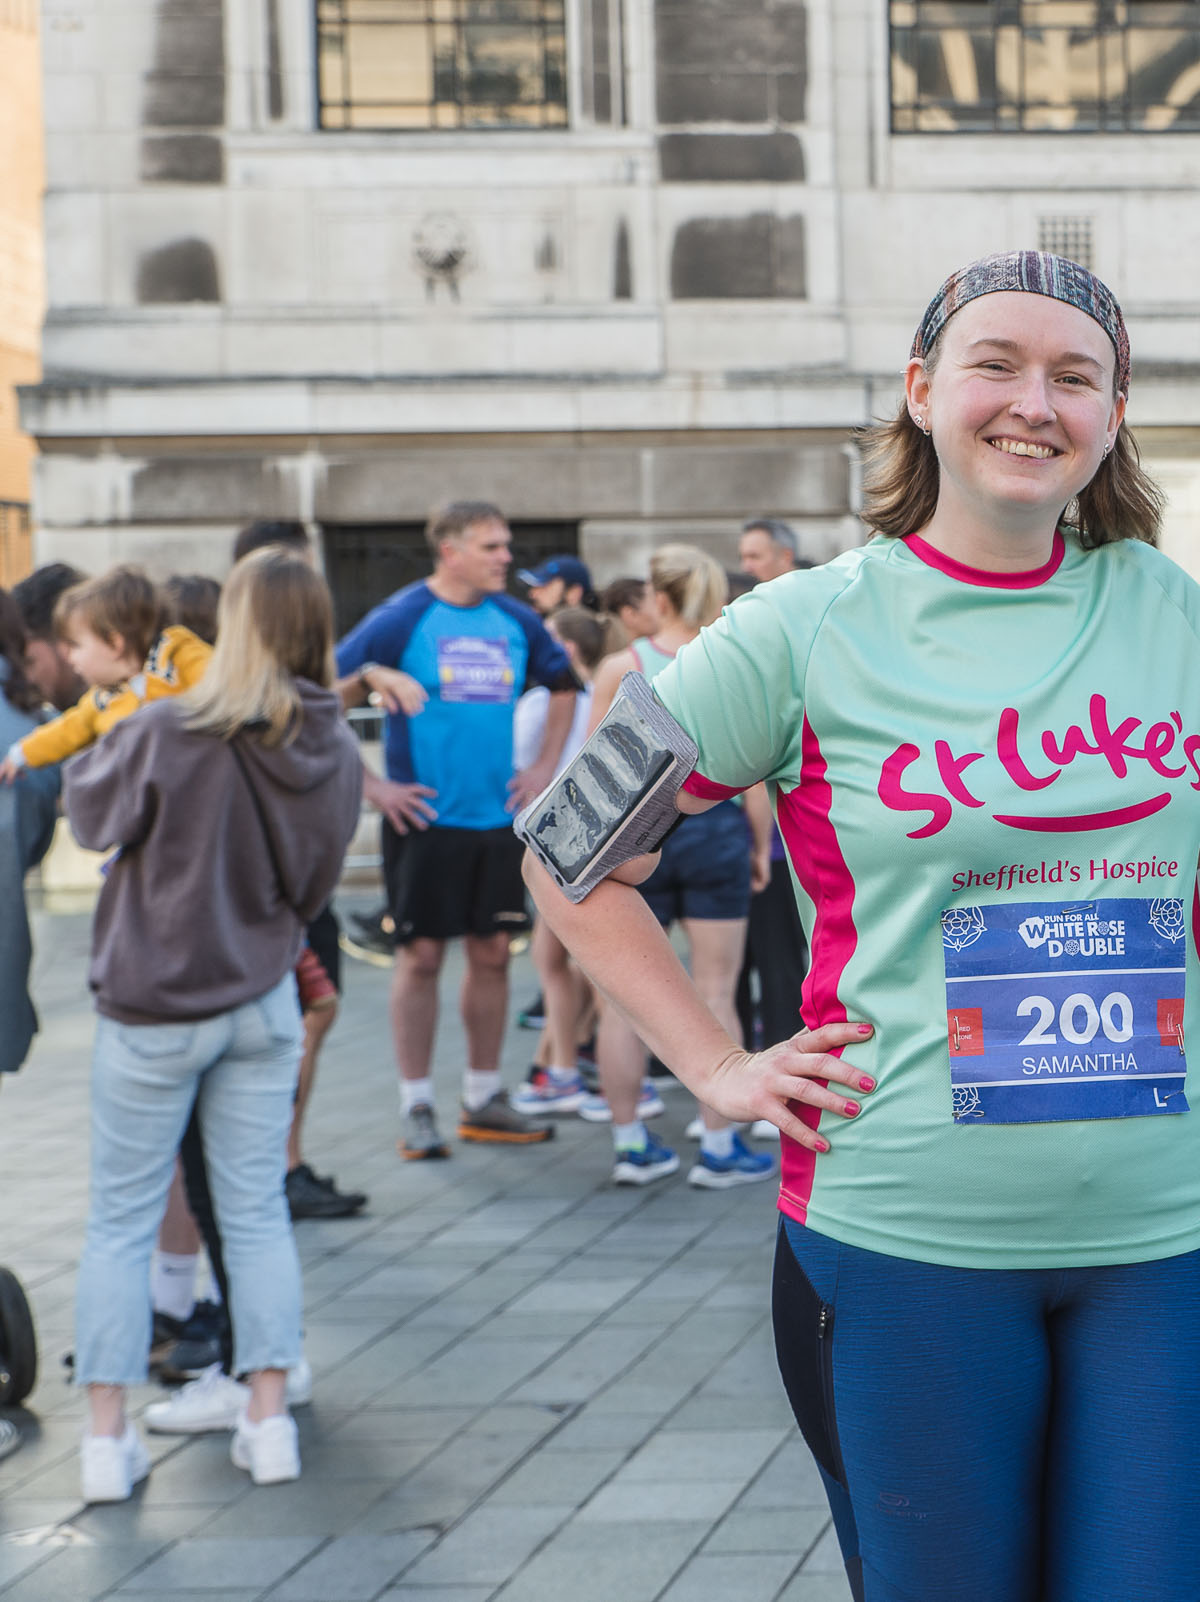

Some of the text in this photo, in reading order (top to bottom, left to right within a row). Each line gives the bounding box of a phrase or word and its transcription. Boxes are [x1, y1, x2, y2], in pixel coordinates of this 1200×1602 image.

[877, 740, 986, 839] St
[952, 856, 1179, 892] Sheffield's Hospice
[1044, 913, 1099, 923] RUN FOR ALL
[1025, 921, 1084, 940] WHITE
[1048, 937, 1126, 958] DOUBLE
[1016, 992, 1134, 1046] 200
[1022, 1053, 1138, 1075] SAMANTHA
[1153, 1087, 1167, 1108] L
